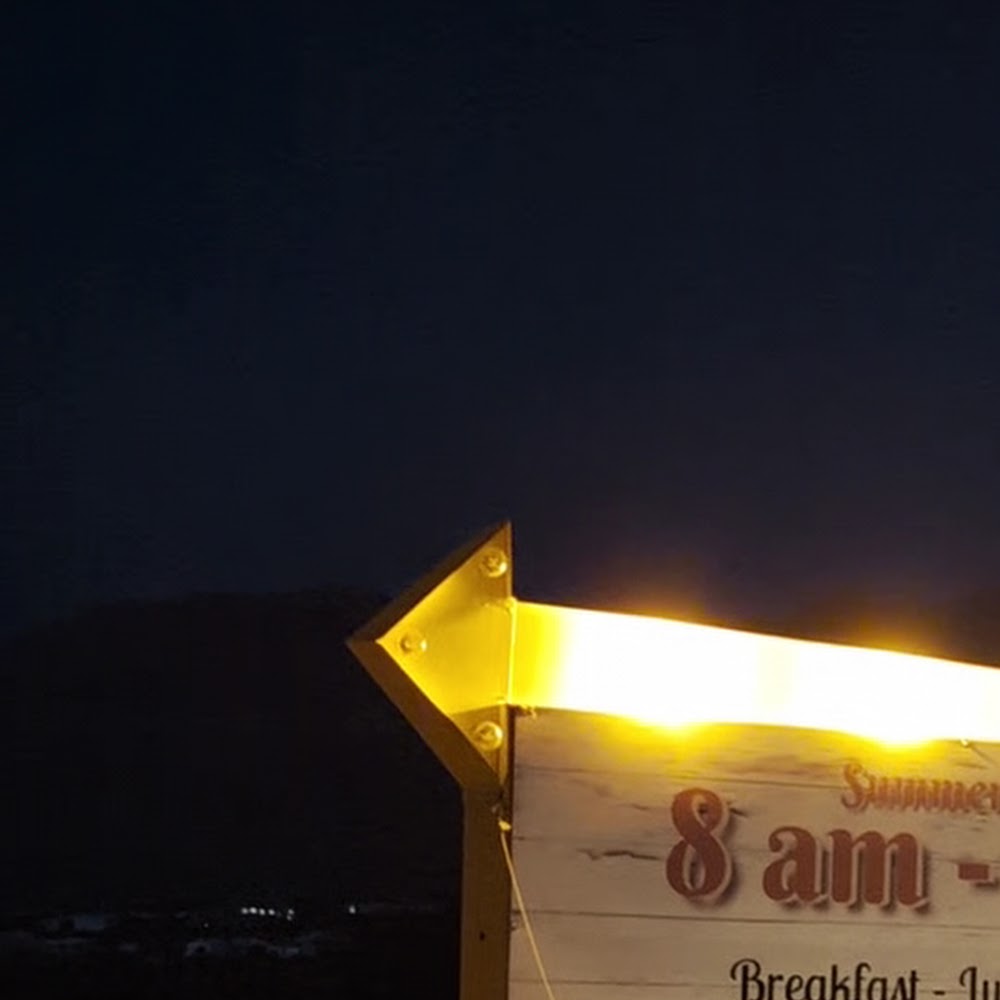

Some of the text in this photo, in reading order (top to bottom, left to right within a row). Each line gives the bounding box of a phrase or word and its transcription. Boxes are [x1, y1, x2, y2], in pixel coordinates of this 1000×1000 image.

[665, 787, 734, 903] 8
[762, 825, 932, 914] am
[957, 861, 996, 885] -
